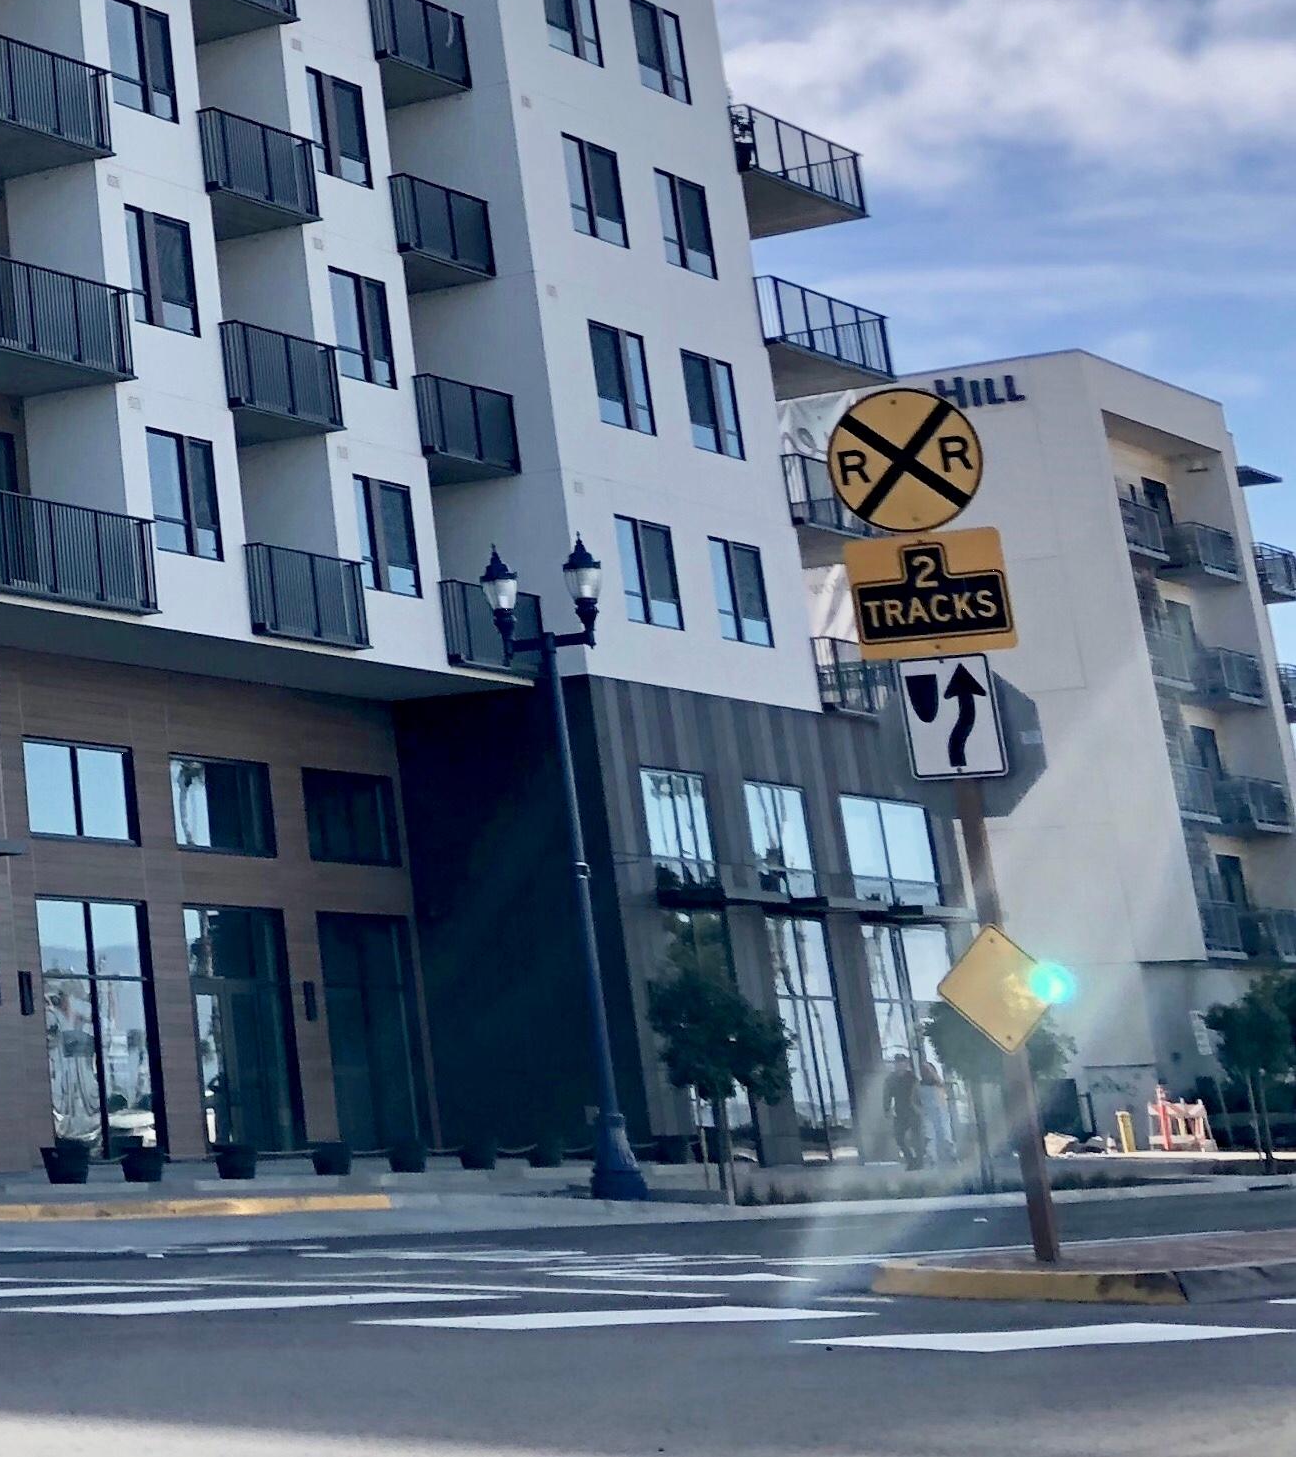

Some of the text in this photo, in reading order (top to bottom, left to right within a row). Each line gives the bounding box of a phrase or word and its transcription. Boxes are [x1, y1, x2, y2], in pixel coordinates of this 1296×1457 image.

[934, 375, 1026, 408] HILL
[837, 435, 974, 486] R R
[911, 555, 939, 588] 2
[864, 589, 997, 628] TRACKS
